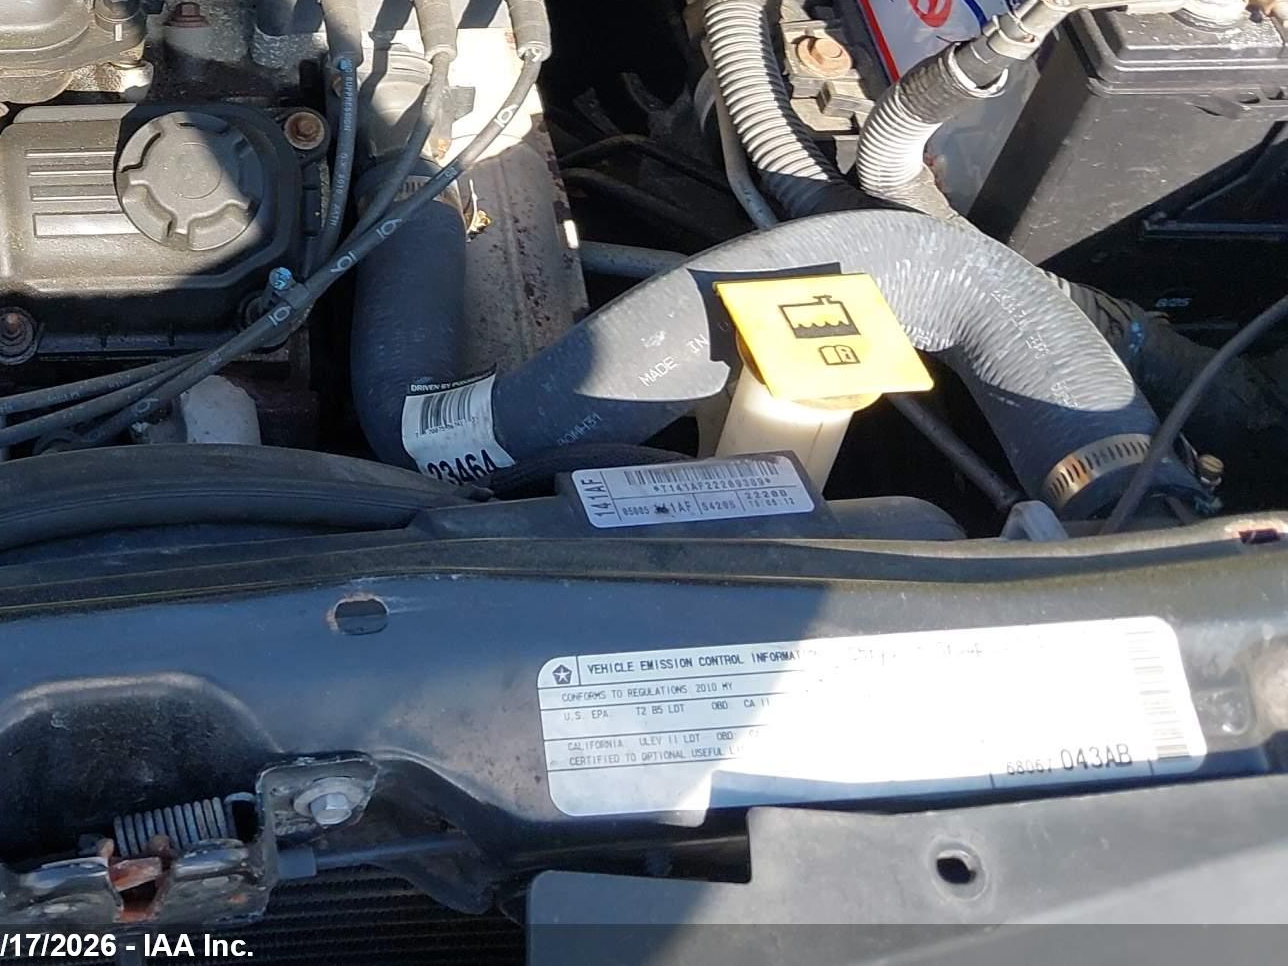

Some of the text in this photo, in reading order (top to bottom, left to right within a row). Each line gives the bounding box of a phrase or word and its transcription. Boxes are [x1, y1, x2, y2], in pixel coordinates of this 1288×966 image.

[638, 356, 678, 386] MADE
[686, 334, 710, 354] IN
[581, 480, 615, 517] 141AF
[588, 653, 744, 675] VEHICLE EMISSION CONTROL
[562, 682, 733, 702] CONFORMS TO REGULATIONS 2010 MY
[636, 704, 684, 716] T2 B5 LDT
[712, 700, 728, 710] OBD
[744, 698, 755, 708] CA
[564, 710, 609, 721] U.S. EPA
[639, 736, 662, 746] ULEV
[684, 733, 700, 744] LDT
[717, 730, 734, 741] OBD
[568, 739, 623, 751] CALIFORNIA
[569, 754, 620, 766] CERTIFIED
[625, 752, 636, 762] TO
[641, 750, 686, 762] OPTIONAL
[691, 746, 724, 758] USEFUL
[1060, 743, 1132, 771] 043AB
